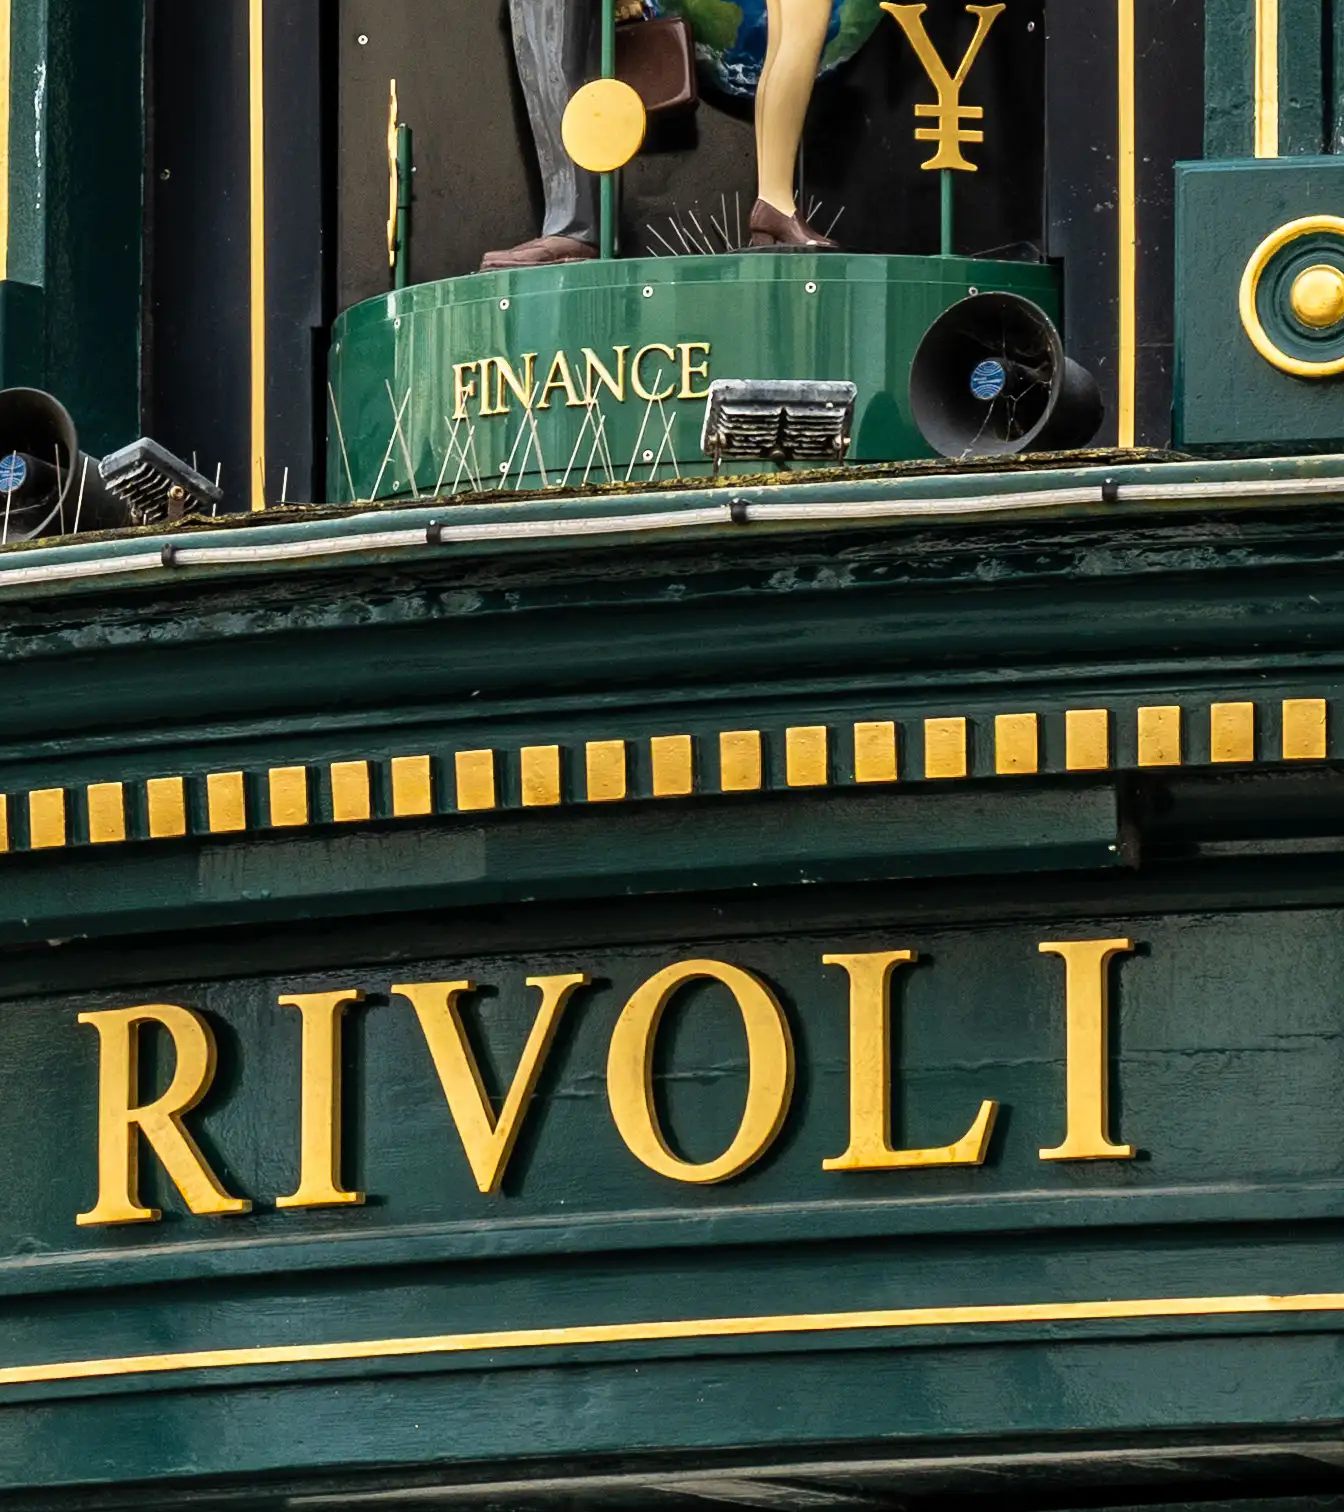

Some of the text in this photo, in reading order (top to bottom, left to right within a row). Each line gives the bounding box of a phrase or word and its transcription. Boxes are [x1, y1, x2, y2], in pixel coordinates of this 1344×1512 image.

[879, 1, 1006, 172] ¥
[451, 342, 712, 420] FINANCE
[75, 937, 1134, 1226] RIVOLI
